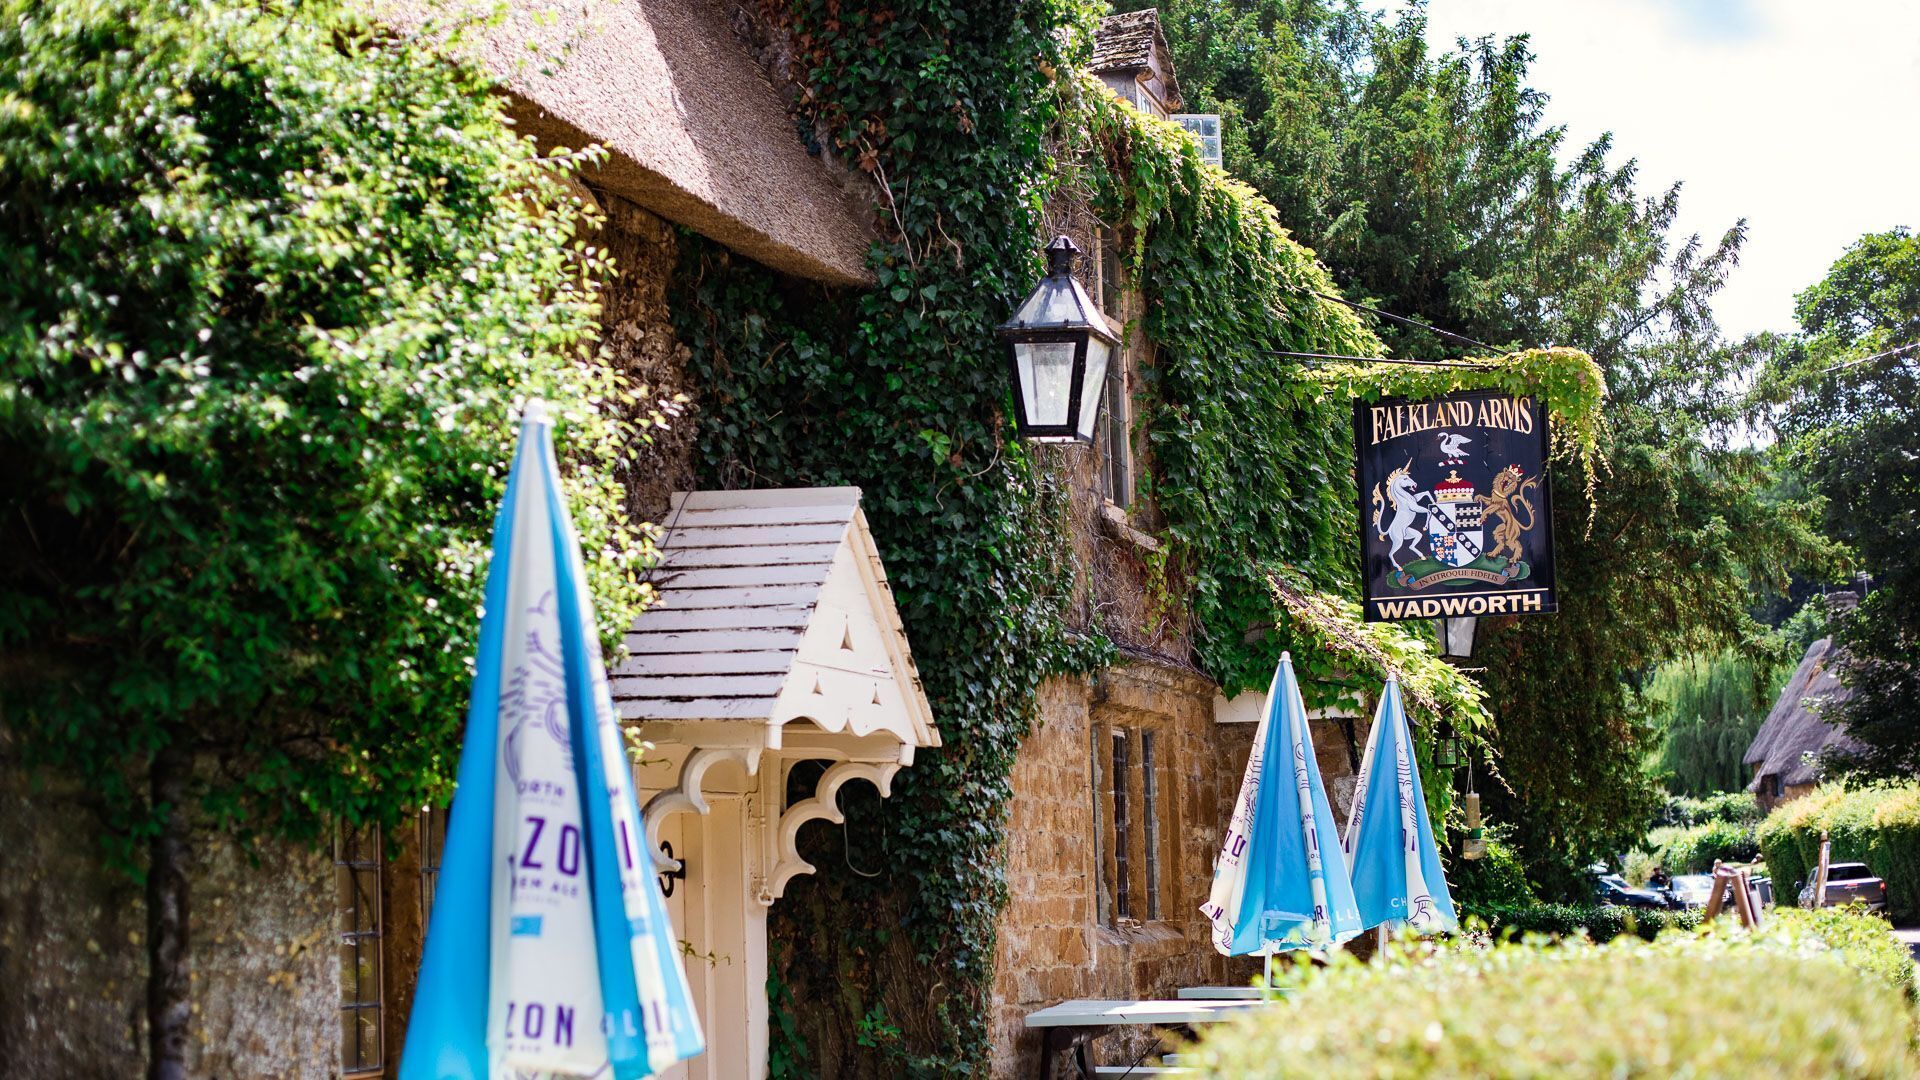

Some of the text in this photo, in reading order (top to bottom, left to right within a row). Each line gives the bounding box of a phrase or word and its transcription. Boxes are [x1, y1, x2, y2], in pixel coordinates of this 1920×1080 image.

[1370, 397, 1533, 445] FALKLAND ARMS
[1418, 579, 1429, 587] IN
[1470, 570, 1499, 582] FIDELIS
[1377, 593, 1542, 619] WADWORTH
